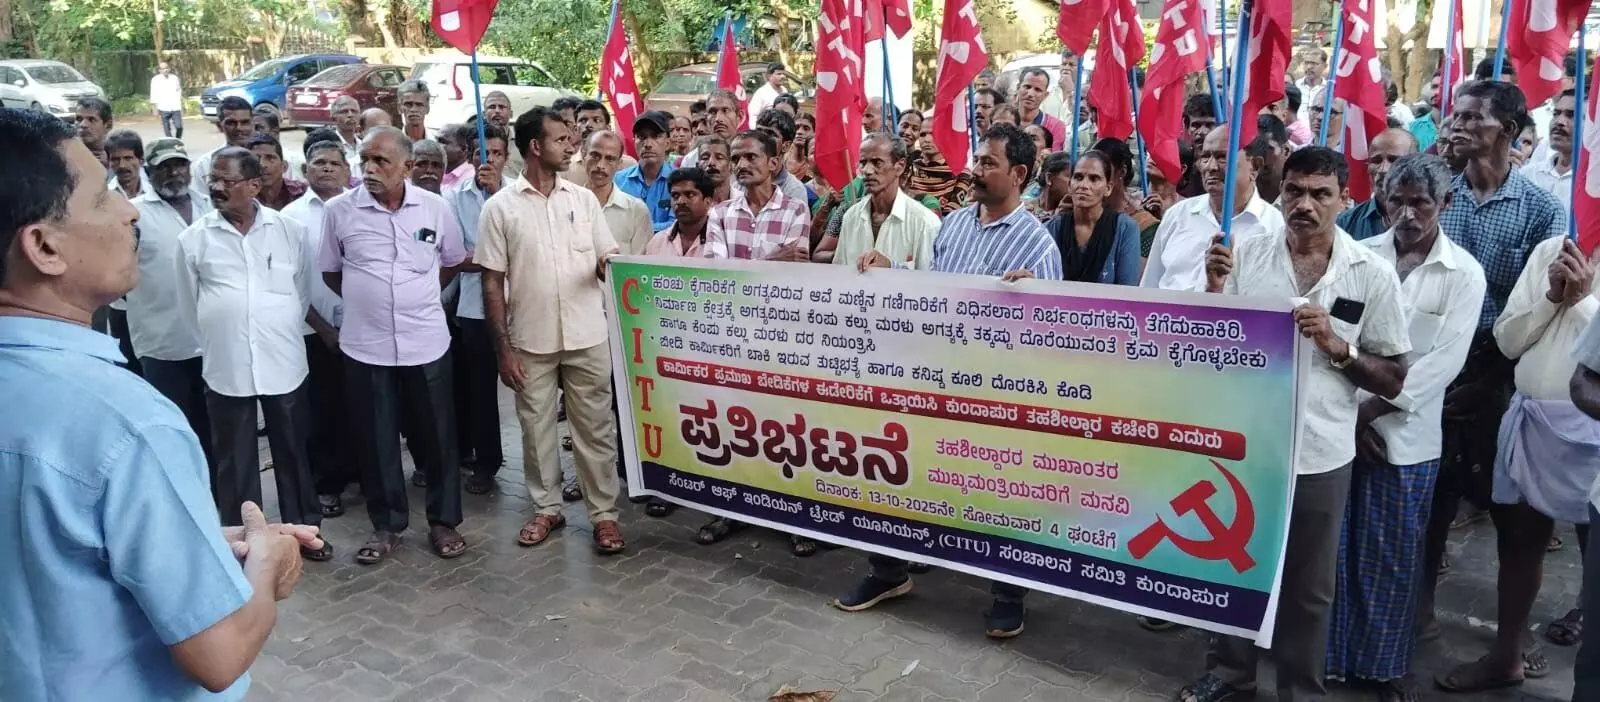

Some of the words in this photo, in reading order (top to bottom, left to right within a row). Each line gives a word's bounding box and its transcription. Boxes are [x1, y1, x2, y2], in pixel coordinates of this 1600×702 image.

[653, 276, 684, 290] ಹಂಚು
[690, 277, 736, 297] ಕೈಗಾರಿಕೆಗೆ
[742, 284, 803, 303] ಅಗತ್ಯವಿರುವ
[810, 288, 832, 303] ಆವೆ
[839, 290, 875, 312] ಮಣ್ಣಿನ
[883, 293, 948, 314] ಗಣಿಗಾರಿಕೆಗೆ
[956, 301, 1024, 320] ವಿಧಿಸಲಾದ
[655, 297, 696, 312] ನಿರ್ಮಾಣ
[704, 300, 735, 321] ಕ್ಷೇತ್ರಕ್ಕೆ
[740, 306, 800, 324] ಅಗತ್ಯವಿರುವ
[807, 309, 837, 325] ಕೆಂಪು
[845, 314, 871, 334] ಕಲ್ಲು
[876, 317, 913, 333] ಮರಳು
[922, 321, 968, 345] ಅಗತ್ಯಕ್ಕೆ
[974, 326, 1013, 349] ತಕ್ಕಷ್ಟು
[1020, 329, 1116, 354] ದೊರೆಯುವಂತೆ
[1126, 340, 1158, 359] ಕ್ರಮ
[1169, 342, 1266, 371] ಕೈಗೊಳ್ಳಬೇಕು
[660, 317, 687, 331] ಹಾಗೂ
[693, 320, 719, 335] ಕೆಂಪು
[727, 326, 749, 344] ಕಲ್ಲು
[754, 328, 788, 342] ಮರಳು
[796, 331, 814, 345] ದರ
[822, 334, 876, 354] ನಿಯಂತ್ರಿಸಿ
[660, 336, 683, 349] ಬೀಡಿ
[689, 340, 741, 358] ಕಾರ್ಮಿಕರಿಗೆ
[748, 349, 770, 362] ಬಾಕಿ
[777, 351, 810, 366] ಇರುವ
[868, 362, 904, 377] ಹಾಗೂ
[952, 371, 982, 386] ಕೂಲಿ
[992, 374, 1048, 394] ದೊರಕಿಸಿ
[1057, 382, 1092, 400] ಕೊಡಿ
[664, 361, 708, 378] ಕಾರ್ಮಿಕರ
[715, 368, 751, 384] ಪ್ರಮುಖ
[758, 373, 810, 394] ಬೇಡಿಕೆಗಳ
[816, 382, 873, 402] ಈಡೇರಿಕೆಗೆ
[946, 398, 1017, 421] ಕುಂದಾಪುರ
[1112, 419, 1159, 440] ಕಚೇರಿ
[1169, 428, 1222, 449] ಎದುರು
[679, 399, 909, 485] ಪ್ರತಿಭಟನೆ
[1033, 453, 1118, 479] ಮುಖಾಂತರ
[816, 479, 861, 499] ದಿನಾಂಕ:
[869, 491, 955, 516] 13-10-2025ನೇ
[963, 506, 1042, 532] ಸೋಮವಾರ
[1050, 524, 1059, 536] 4
[1068, 527, 1116, 549] ಘಂಟೆಗೆ
[1081, 491, 1130, 515] ಮನವಿ
[669, 473, 705, 492] ಸೆಂಟರ್
[743, 492, 802, 514] ಇಂಡಿಯನ್
[810, 505, 845, 522] ಟ್ರೇಡ್
[939, 534, 990, 557] (CITU)
[999, 545, 1071, 573] ಸಂಚಾಲನ
[1082, 563, 1126, 586] ಸಮಿತಿ
[1136, 575, 1229, 608] ಕುಂದಾಪುರ
